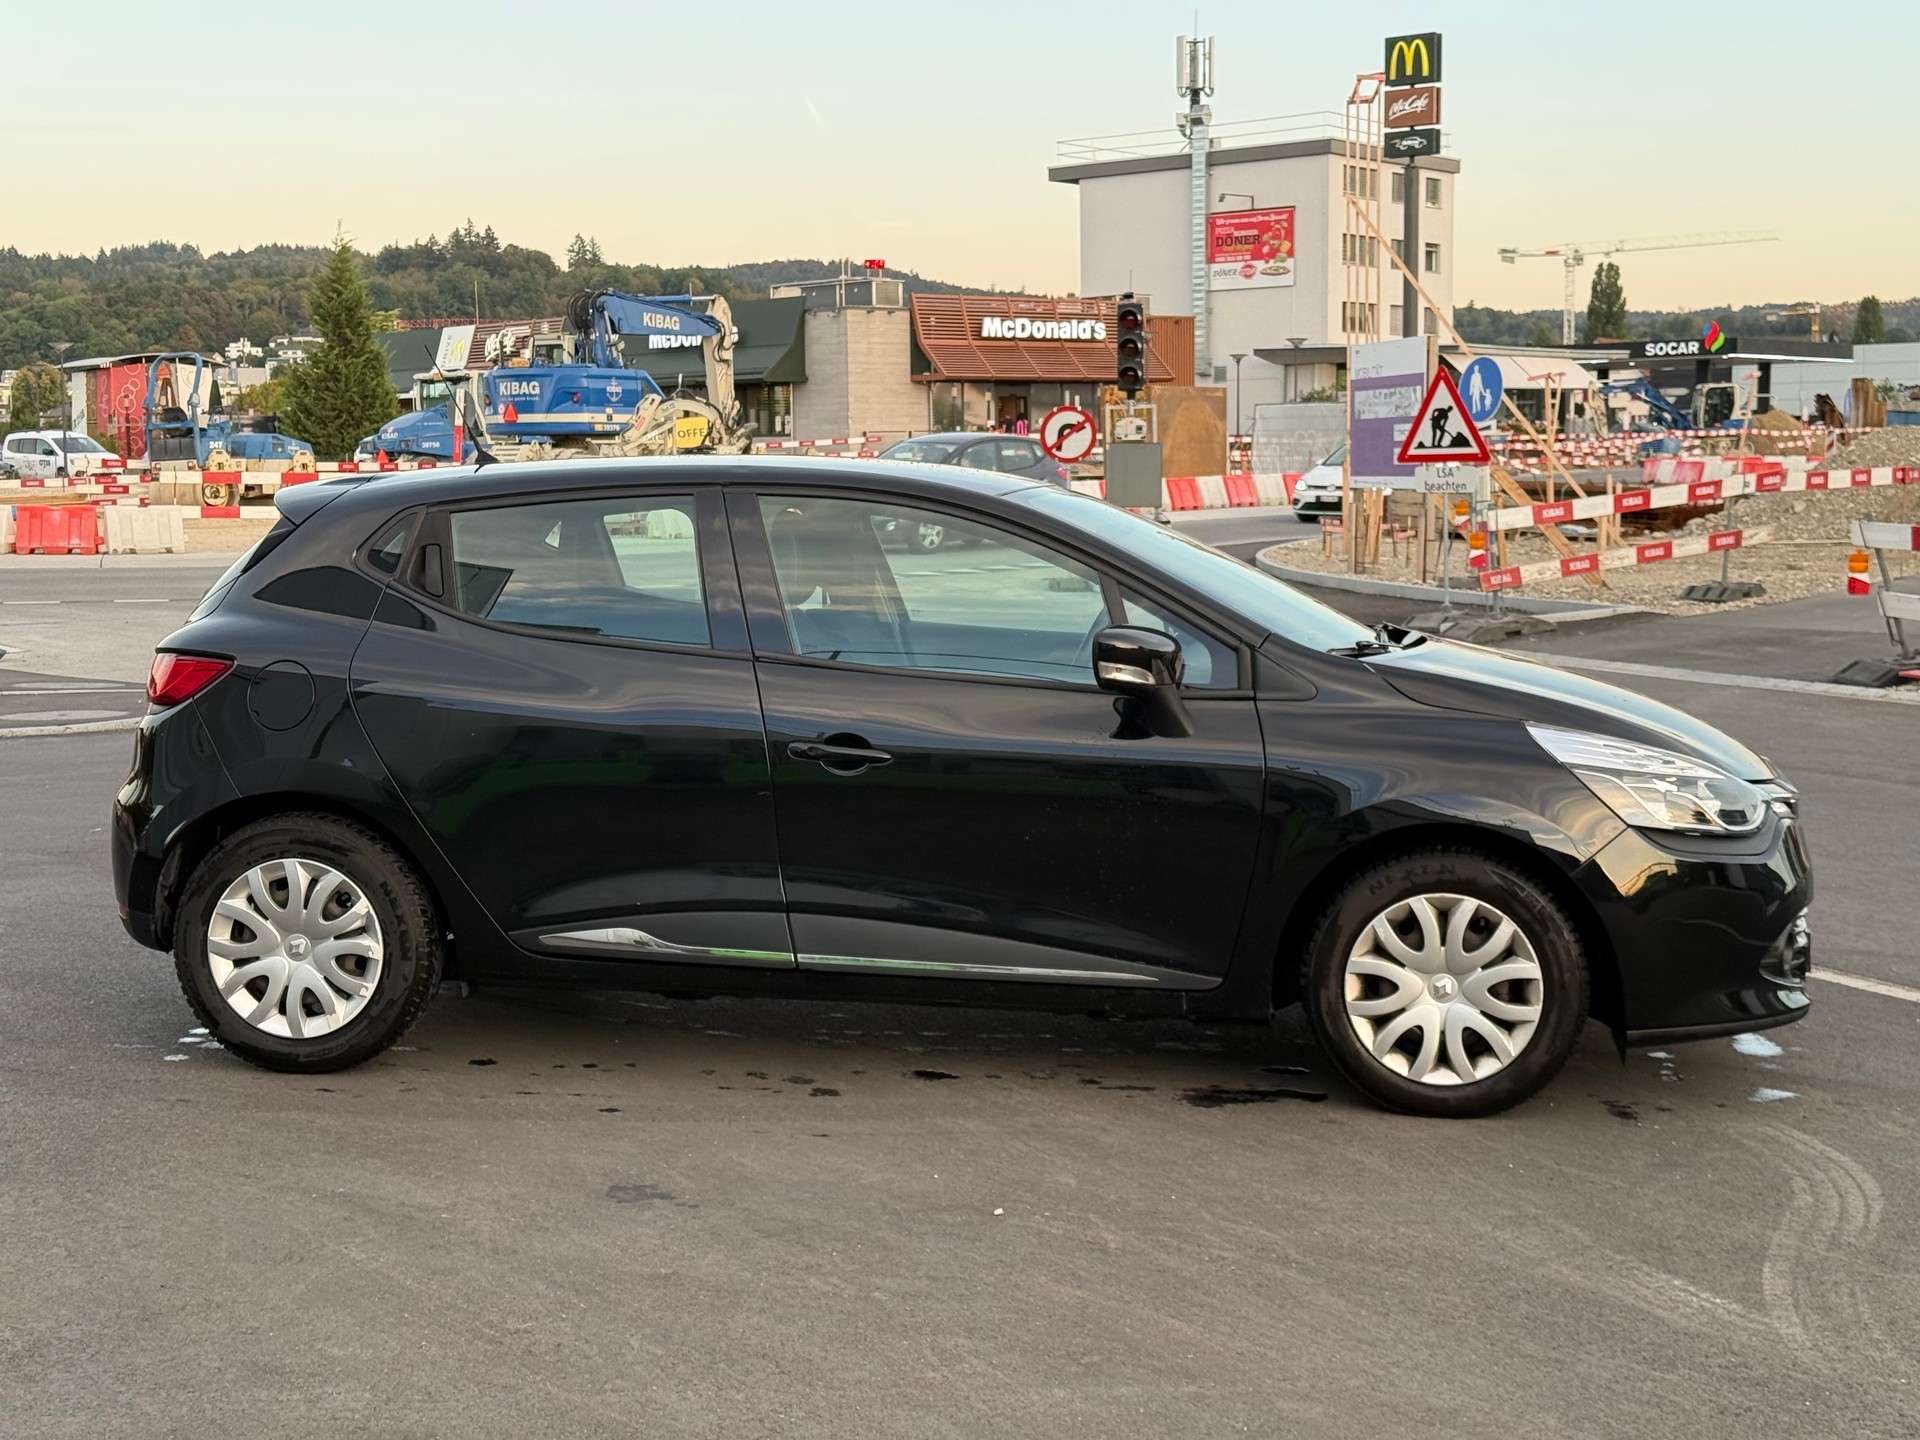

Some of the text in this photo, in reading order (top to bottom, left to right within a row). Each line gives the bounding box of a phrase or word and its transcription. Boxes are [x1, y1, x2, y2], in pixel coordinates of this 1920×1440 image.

[1215, 233, 1261, 247] DÖNER
[643, 312, 680, 330] KIBAG
[981, 316, 1107, 340] McDonald's
[1645, 341, 1700, 356] SOCAR
[500, 381, 540, 395] KIBAG
[209, 441, 223, 449] 247
[1436, 468, 1454, 478] LSA
[1424, 481, 1467, 491] beachten
